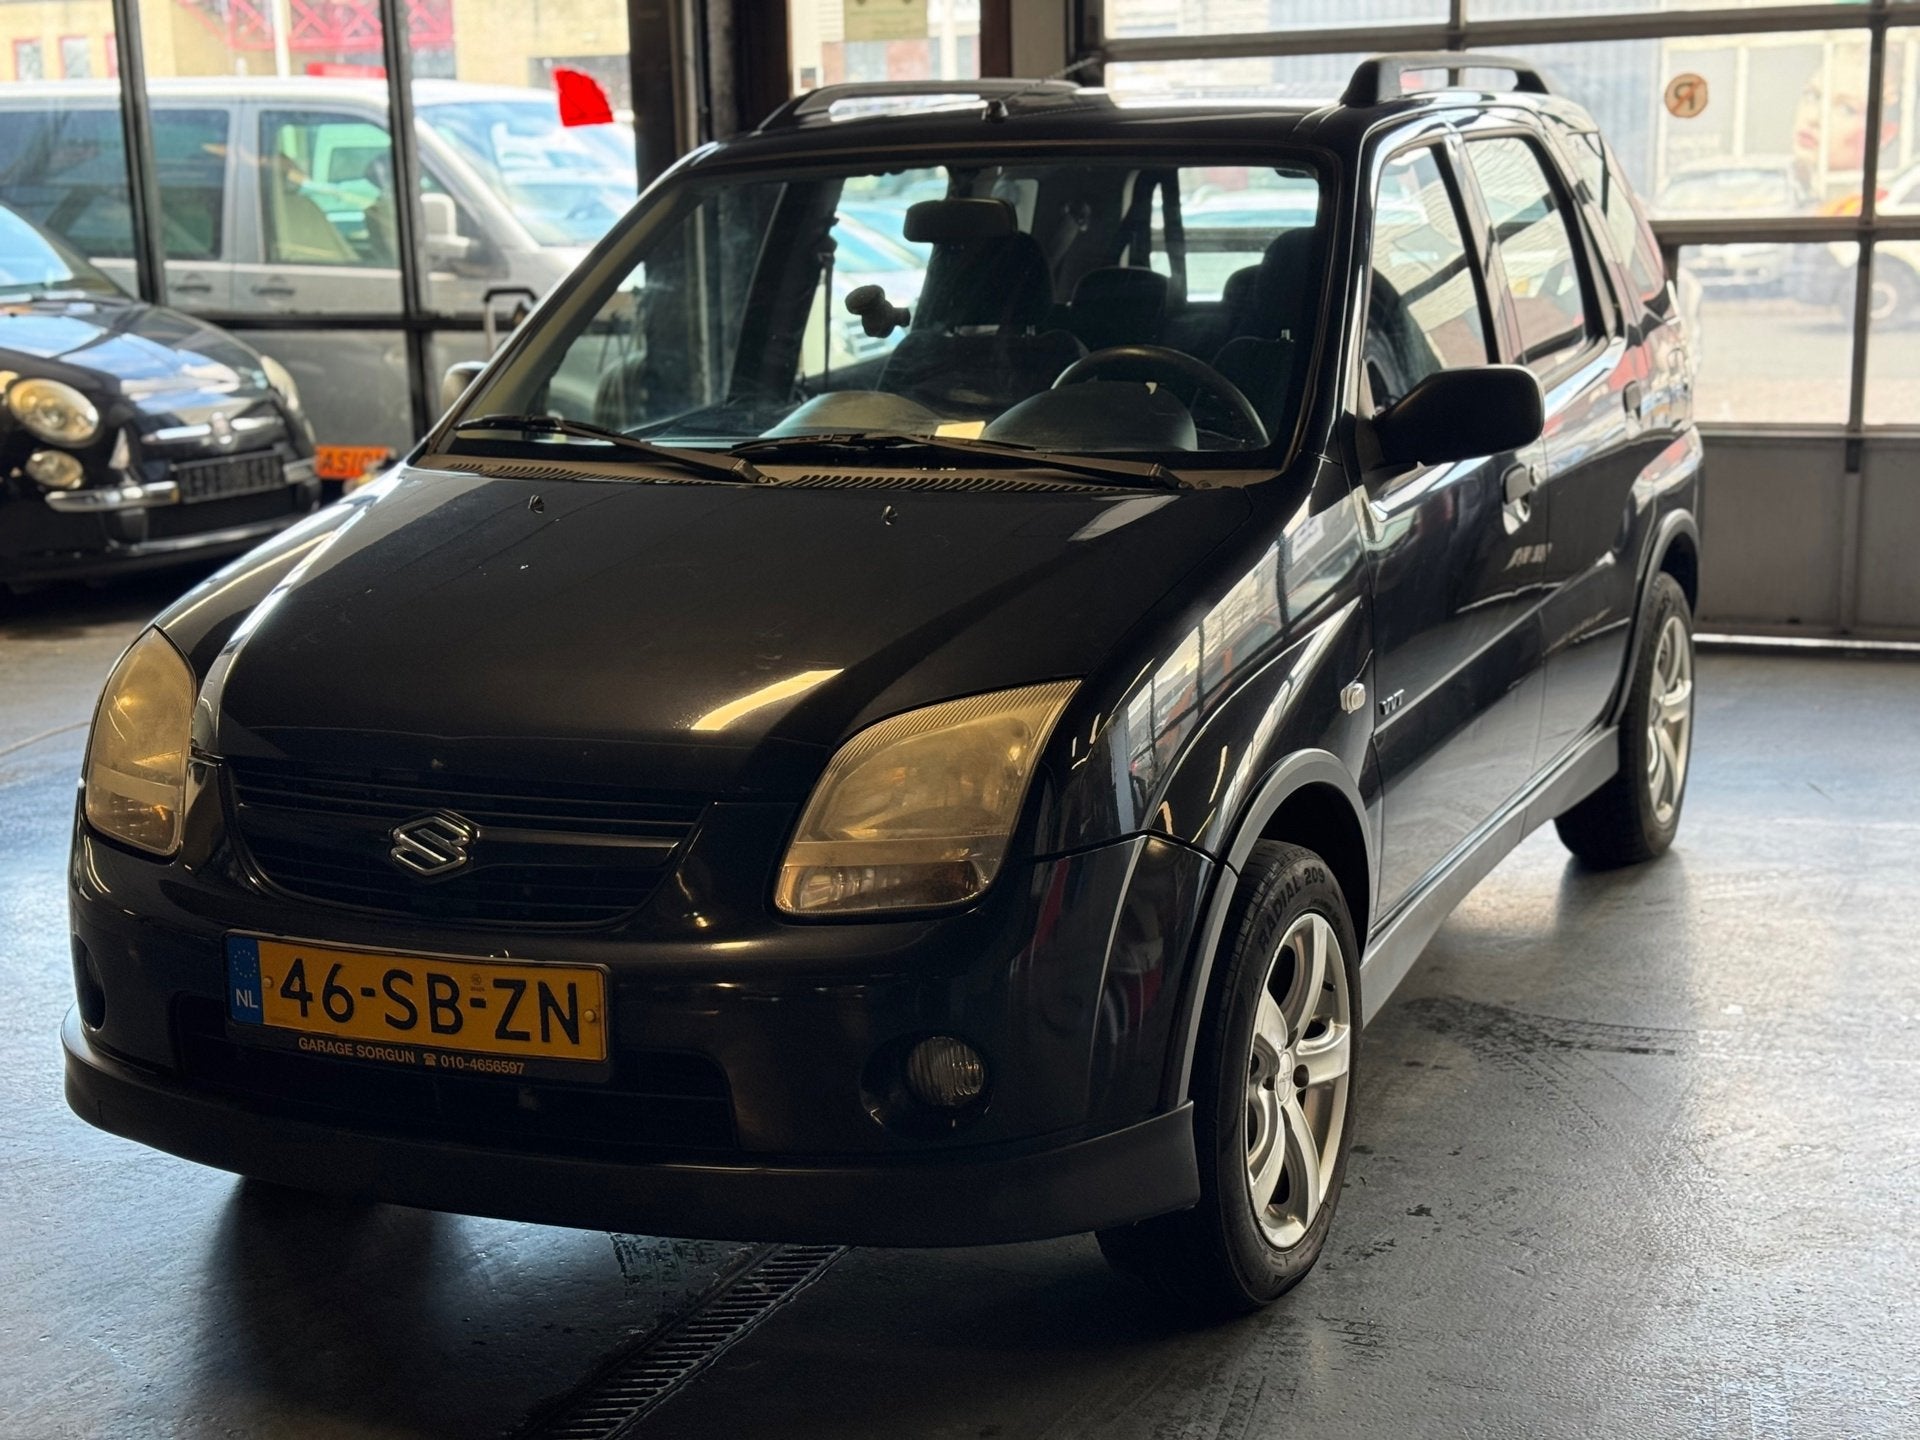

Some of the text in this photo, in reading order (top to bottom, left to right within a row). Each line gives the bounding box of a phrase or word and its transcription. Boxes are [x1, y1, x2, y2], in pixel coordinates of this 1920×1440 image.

[1304, 867, 1325, 886] 209
[235, 988, 259, 1009] NL
[279, 958, 581, 1045] 46-SB-ZN
[299, 1037, 525, 1075] GARAGE SORGUN 010-4656597
